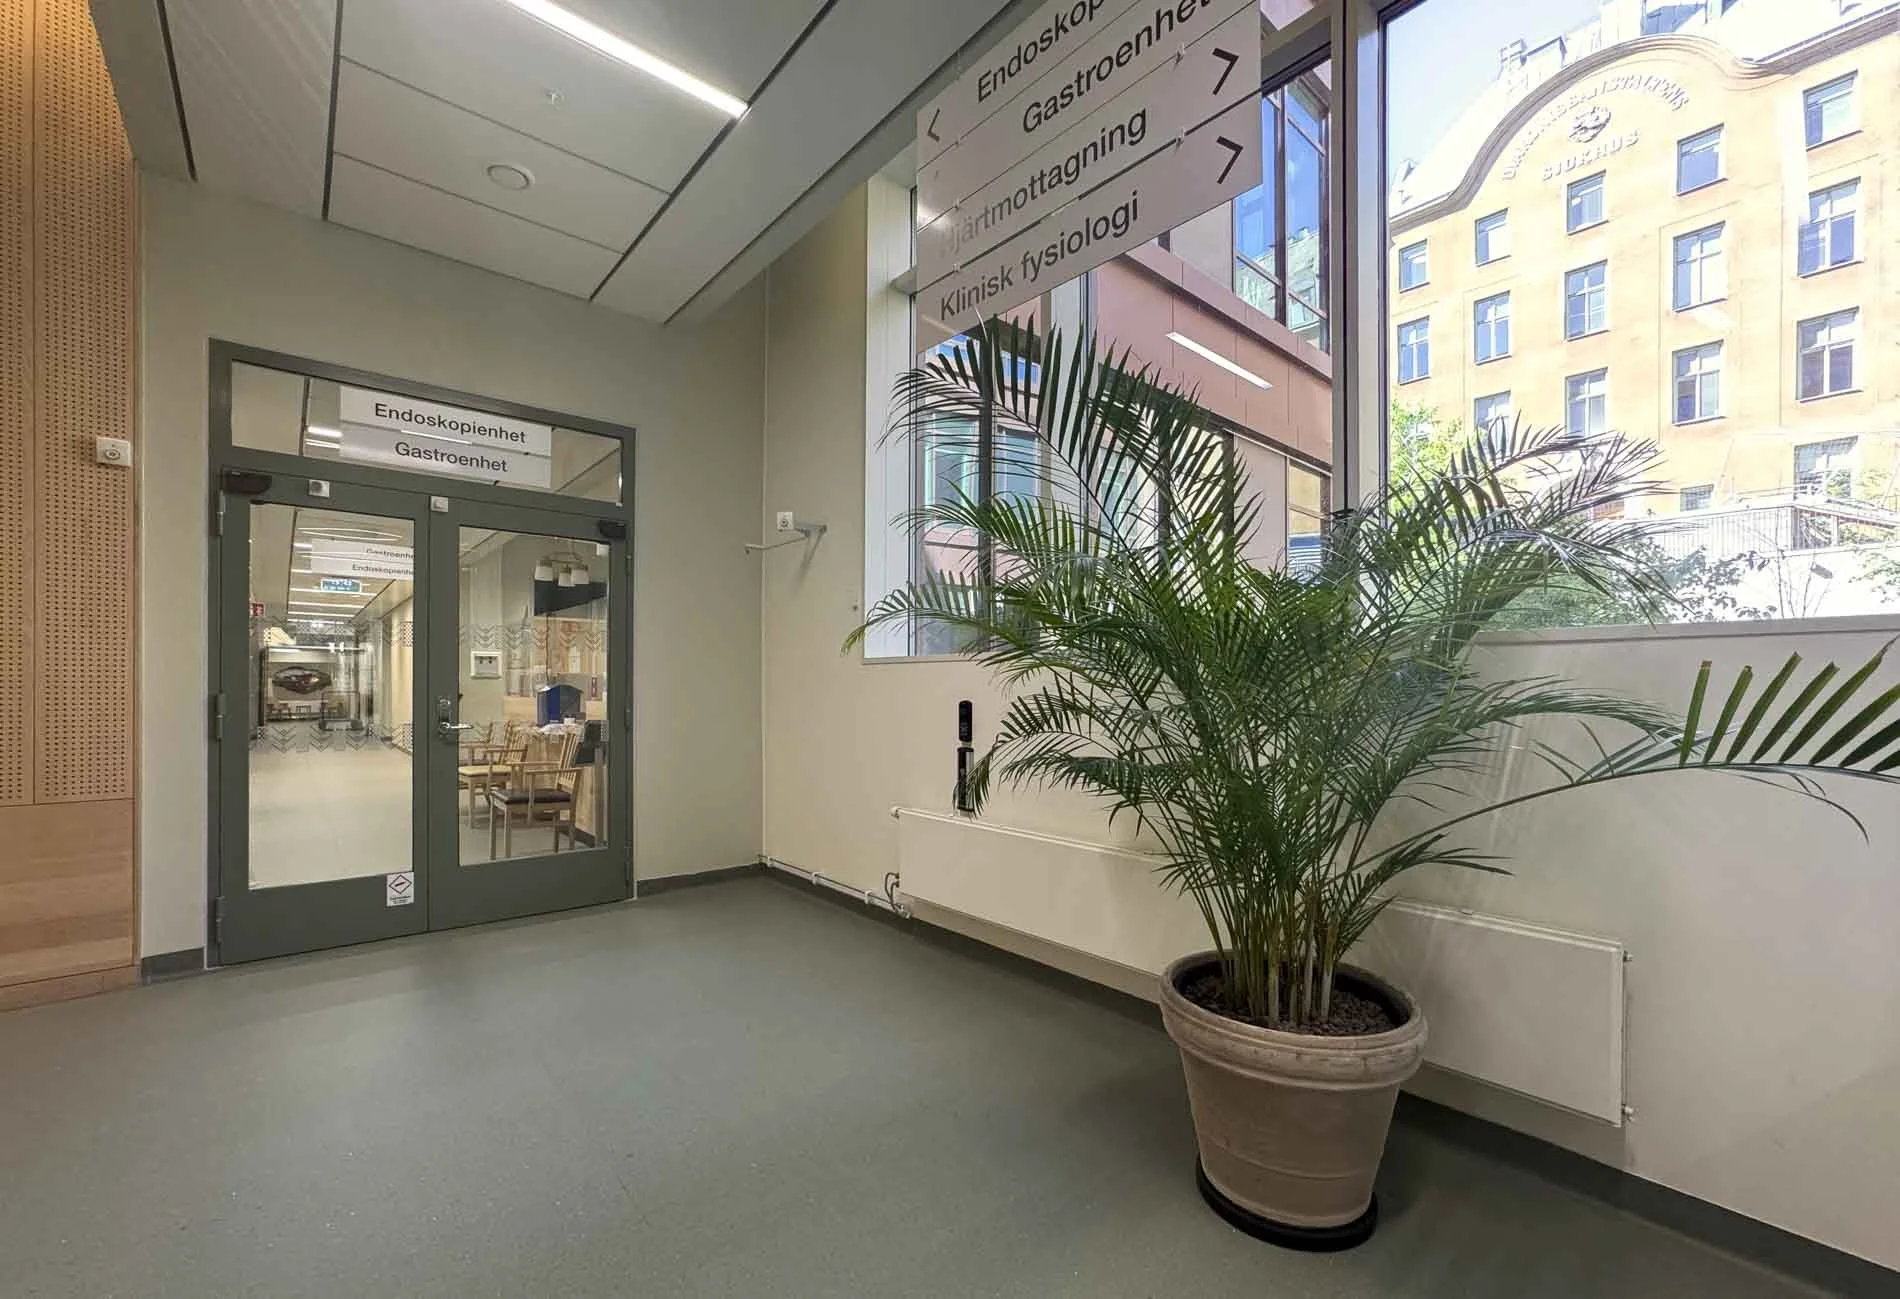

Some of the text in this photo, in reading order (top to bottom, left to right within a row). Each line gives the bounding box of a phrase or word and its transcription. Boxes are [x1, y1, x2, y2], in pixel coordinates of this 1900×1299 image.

[1023, 0, 1210, 133] Gastroenhe
[940, 190, 1138, 320] Klinisk fysiologi
[374, 402, 526, 443] Endoskopienhet
[394, 441, 508, 473] Gastroenhet
